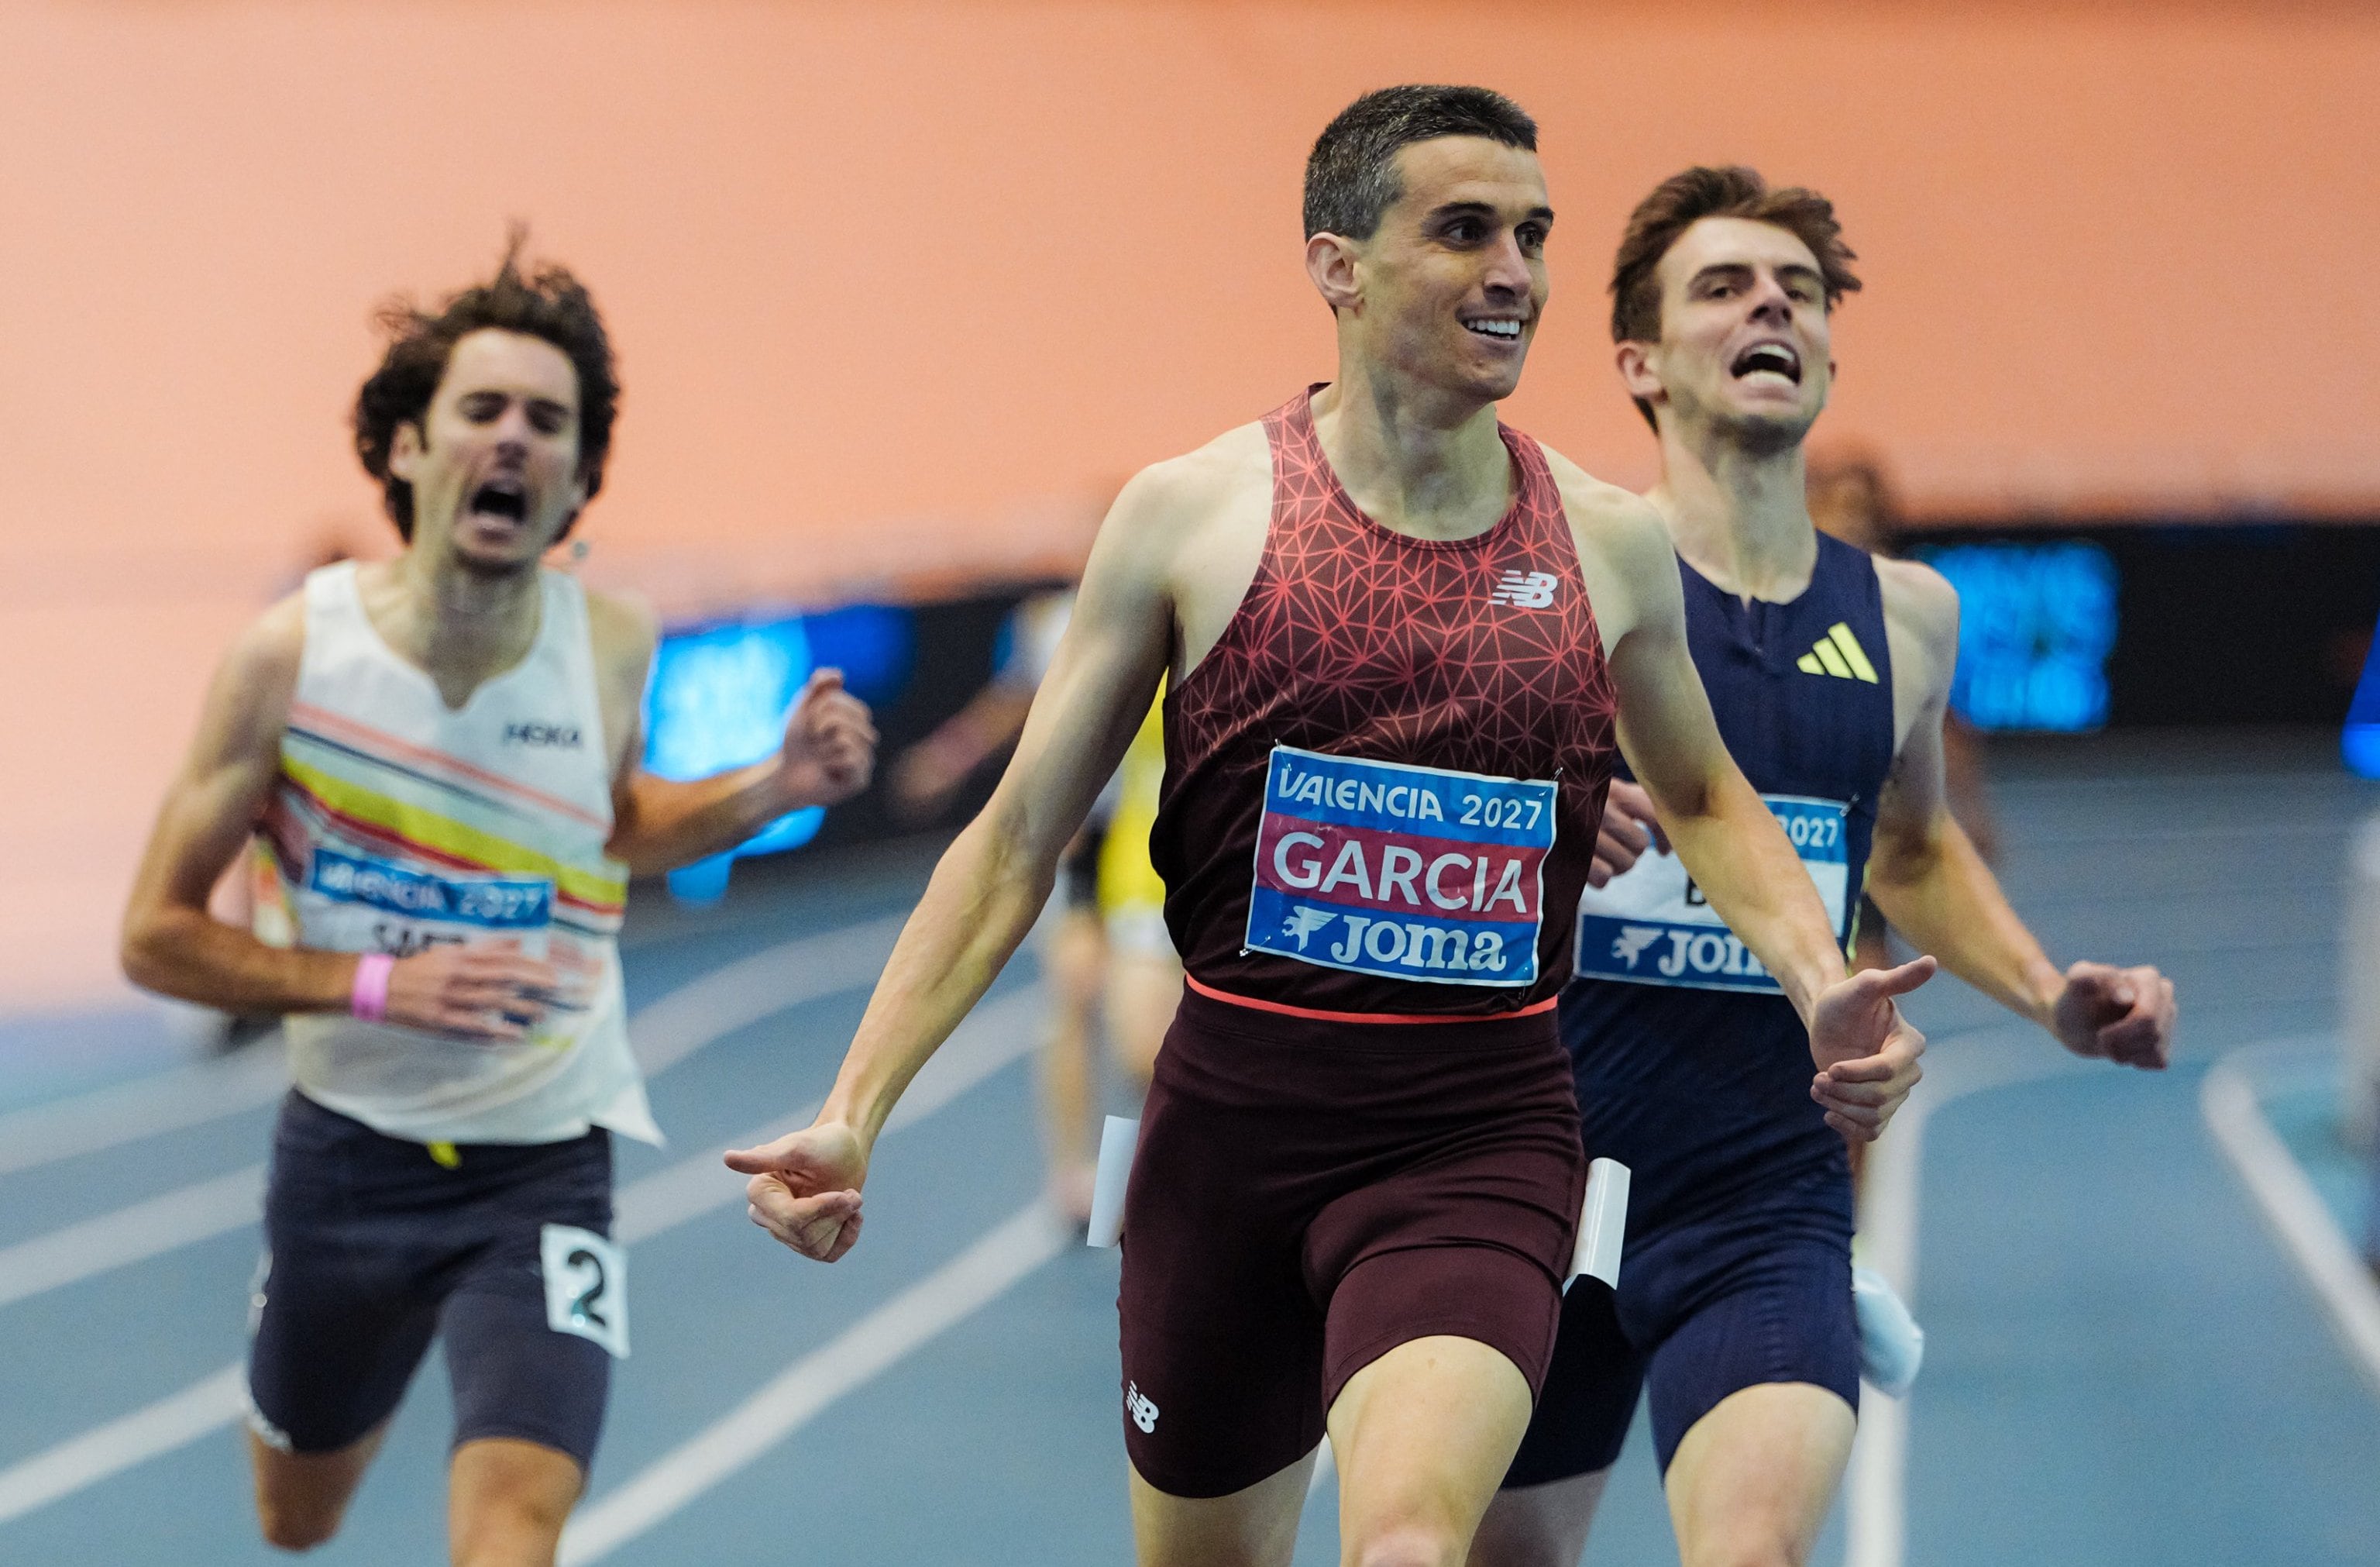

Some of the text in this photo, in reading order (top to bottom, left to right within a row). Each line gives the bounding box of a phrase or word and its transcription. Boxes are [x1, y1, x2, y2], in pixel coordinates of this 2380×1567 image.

[1278, 767, 1543, 831] VALENCIA 2027
[1273, 831, 1528, 914] GARCIA
[1330, 914, 1507, 972] Joma
[568, 1249, 605, 1327] 2
